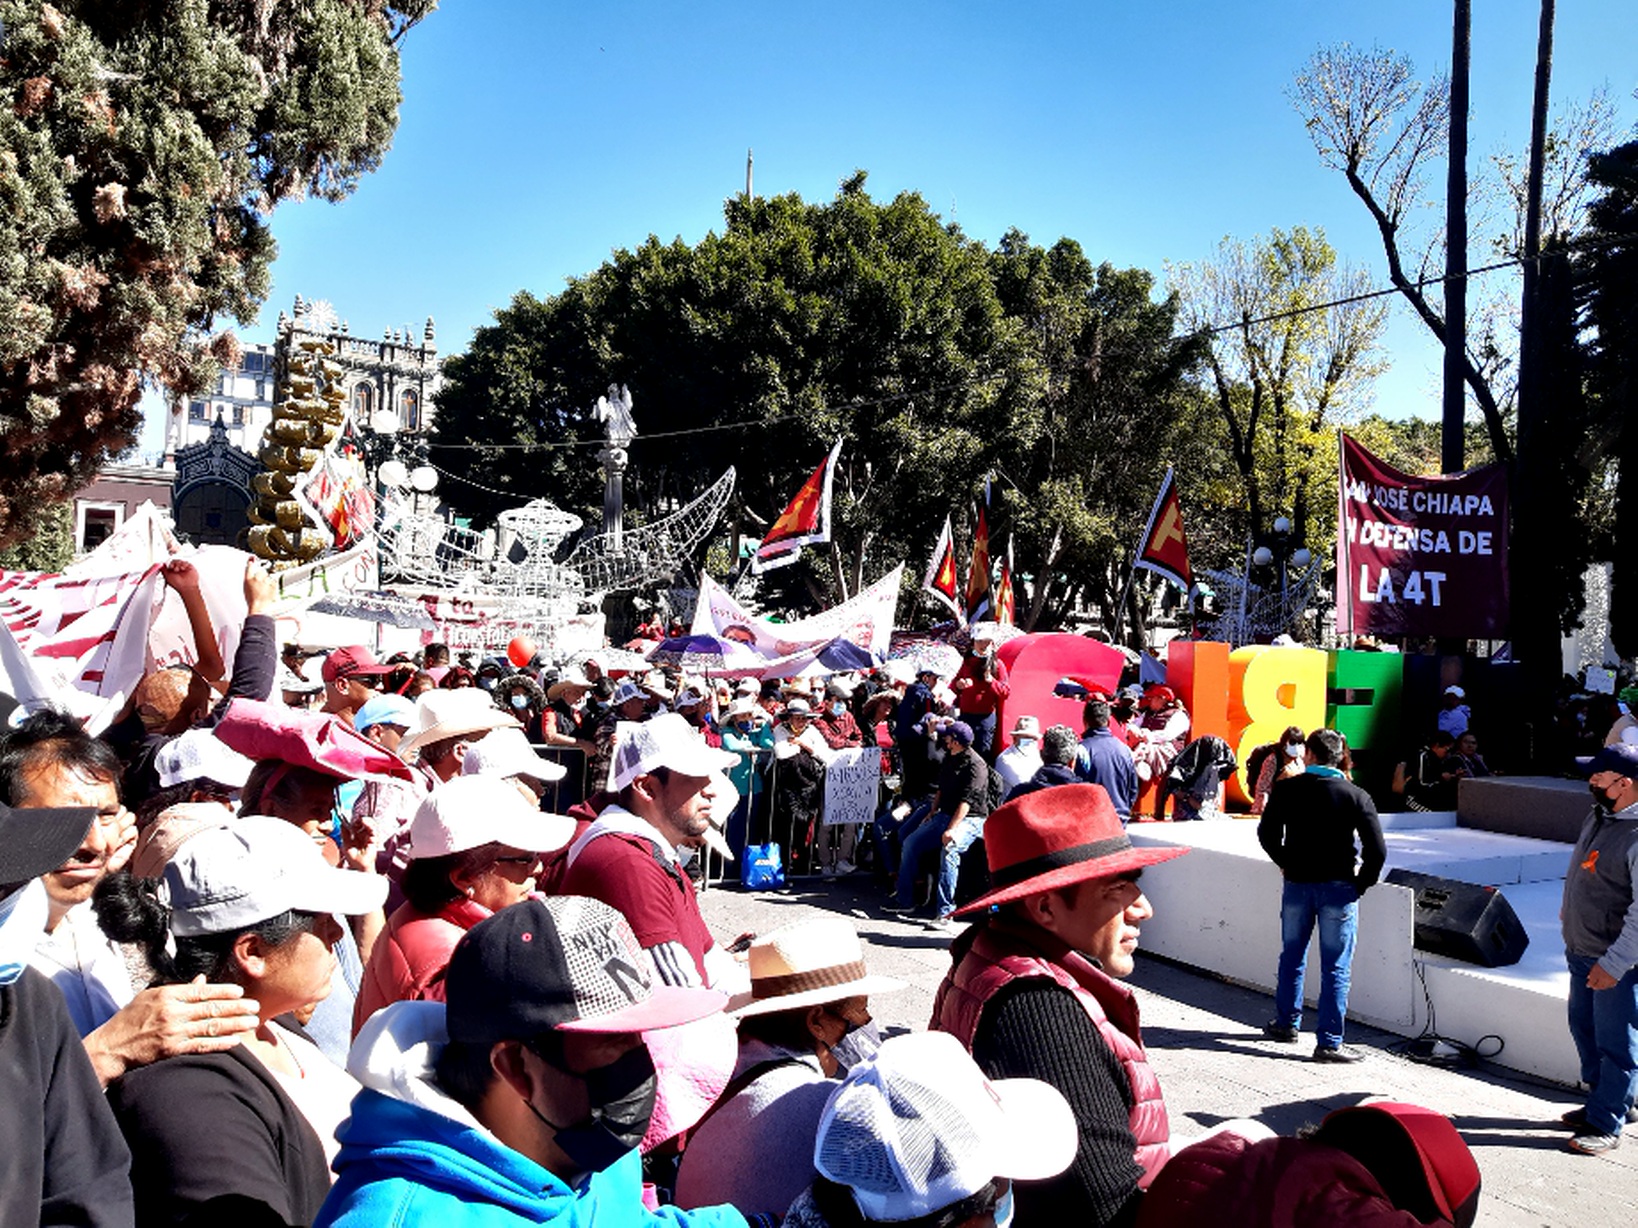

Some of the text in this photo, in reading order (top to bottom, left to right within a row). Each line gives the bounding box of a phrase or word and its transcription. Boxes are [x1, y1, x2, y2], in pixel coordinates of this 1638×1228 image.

[1413, 491, 1494, 516] CHIAPA
[1360, 521, 1452, 554] DEFENSA
[1458, 530, 1493, 555] DE
[1359, 564, 1447, 608] LA 4T
